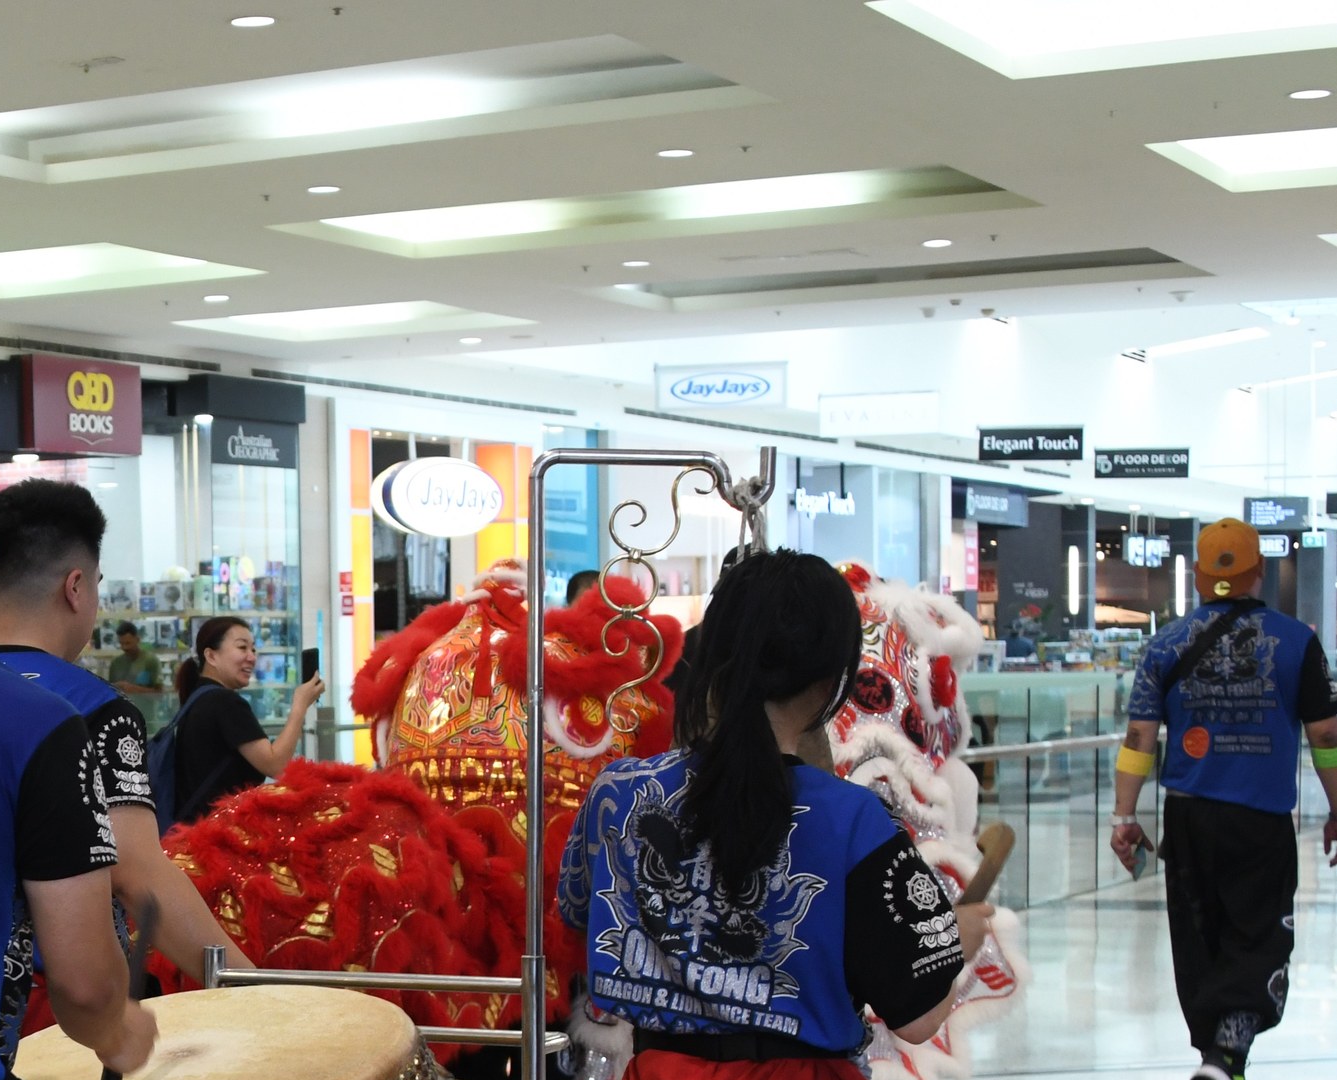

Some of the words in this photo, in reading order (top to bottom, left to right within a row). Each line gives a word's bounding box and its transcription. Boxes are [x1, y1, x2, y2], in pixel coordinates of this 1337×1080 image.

[67, 371, 114, 412] QBD
[680, 379, 762, 398] JayJays
[69, 413, 113, 435] BOOKS
[982, 436, 1034, 454] Elegant
[1036, 435, 1079, 450] Touch
[1114, 454, 1149, 465] FLOOR
[1151, 453, 1188, 465] DEKOR
[420, 476, 499, 515] JayJays
[685, 960, 772, 1006] FONG
[594, 975, 653, 1005] DRAGON
[654, 988, 669, 1006] &
[753, 1010, 800, 1036] TEAM
